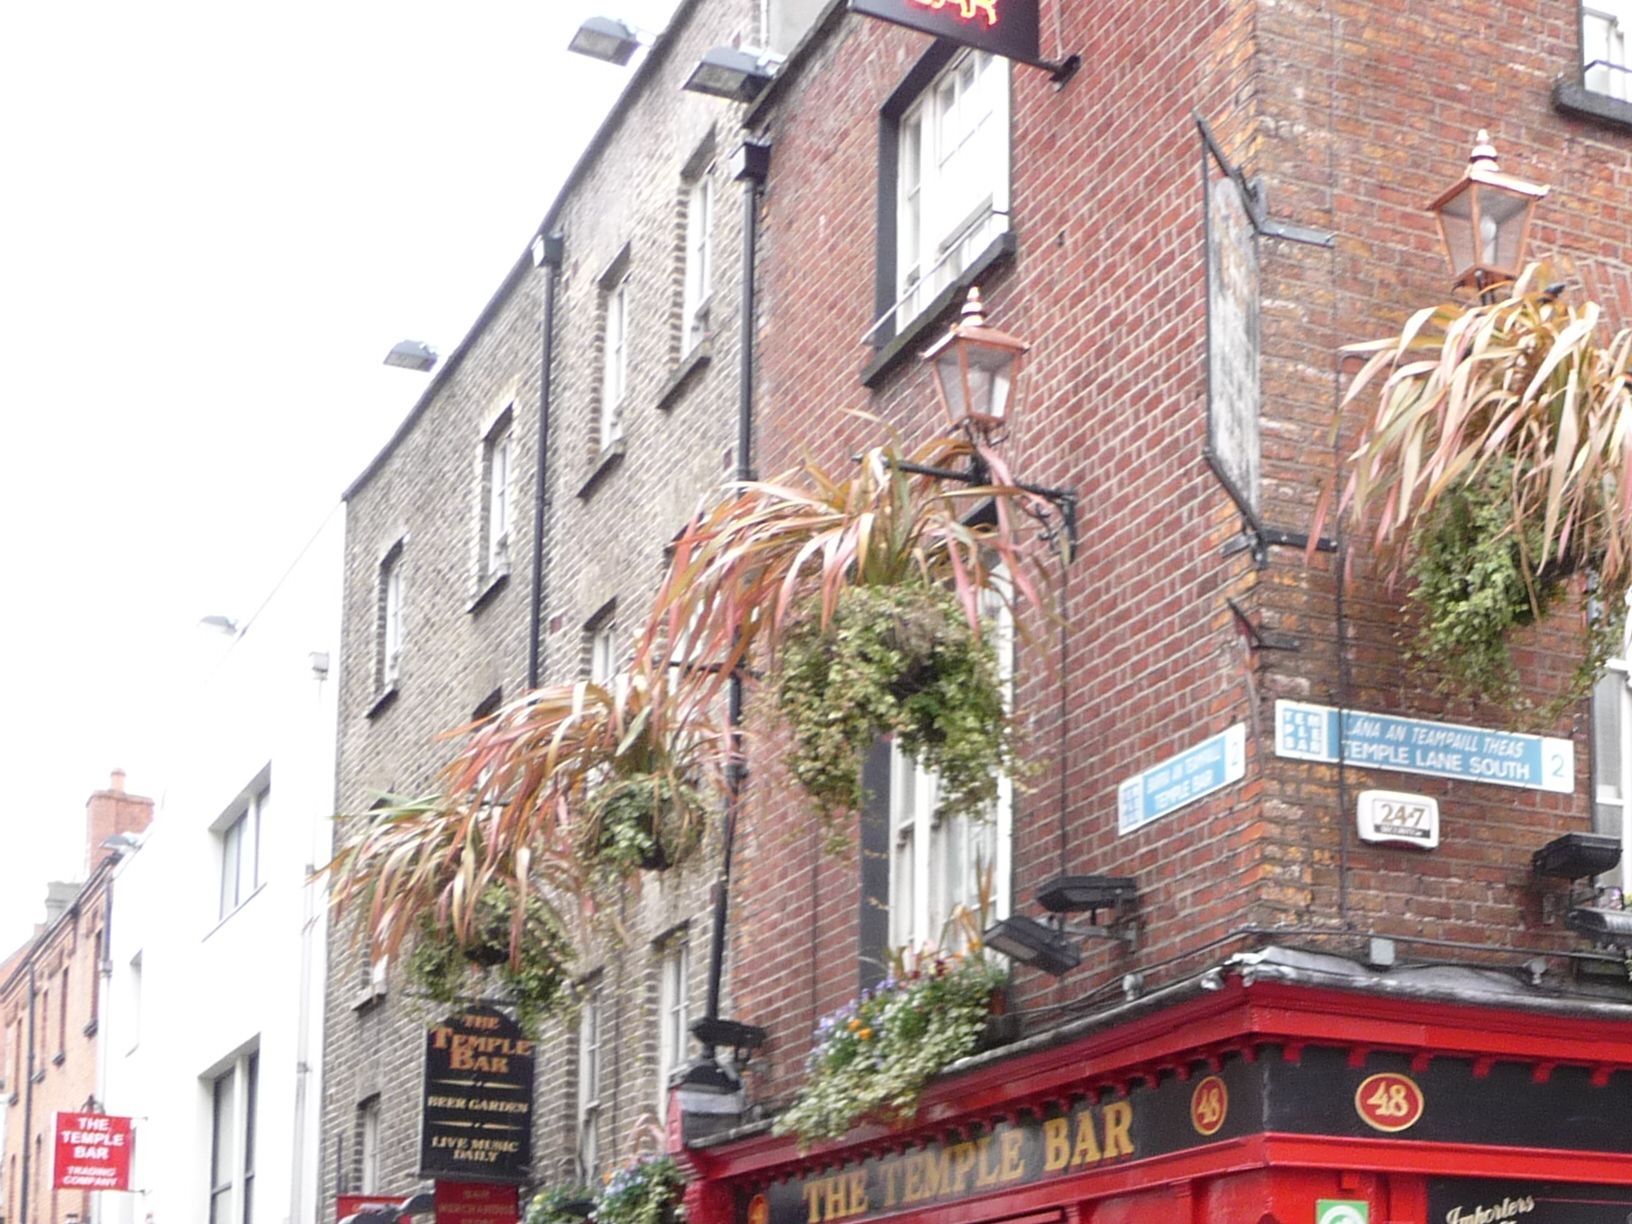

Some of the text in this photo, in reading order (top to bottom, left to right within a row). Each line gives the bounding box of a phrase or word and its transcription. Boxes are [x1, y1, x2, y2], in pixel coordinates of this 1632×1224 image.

[1386, 725, 1407, 742] AN
[1411, 727, 1479, 752] TEAMPAILL
[1482, 736, 1526, 758] THEAS
[1342, 740, 1531, 780] TEMPLE LANE SOUTH
[1550, 753, 1565, 778] 2
[464, 1014, 500, 1030] THE
[430, 1027, 536, 1056] TEMPLE
[450, 1046, 510, 1073] BAR
[427, 1095, 529, 1114] BEER GARDEN
[1366, 1080, 1409, 1118] 48
[78, 1117, 110, 1131] THE
[61, 1130, 125, 1147] TEMPLE
[431, 1136, 519, 1152] LIVE MUSIC
[880, 1128, 1027, 1206] TEMPLE
[1043, 1101, 1135, 1173] BAR
[1196, 1083, 1221, 1126] 48
[73, 1145, 109, 1160] BAR
[453, 1149, 499, 1162] DAILY
[62, 1175, 118, 1187] COMPANY
